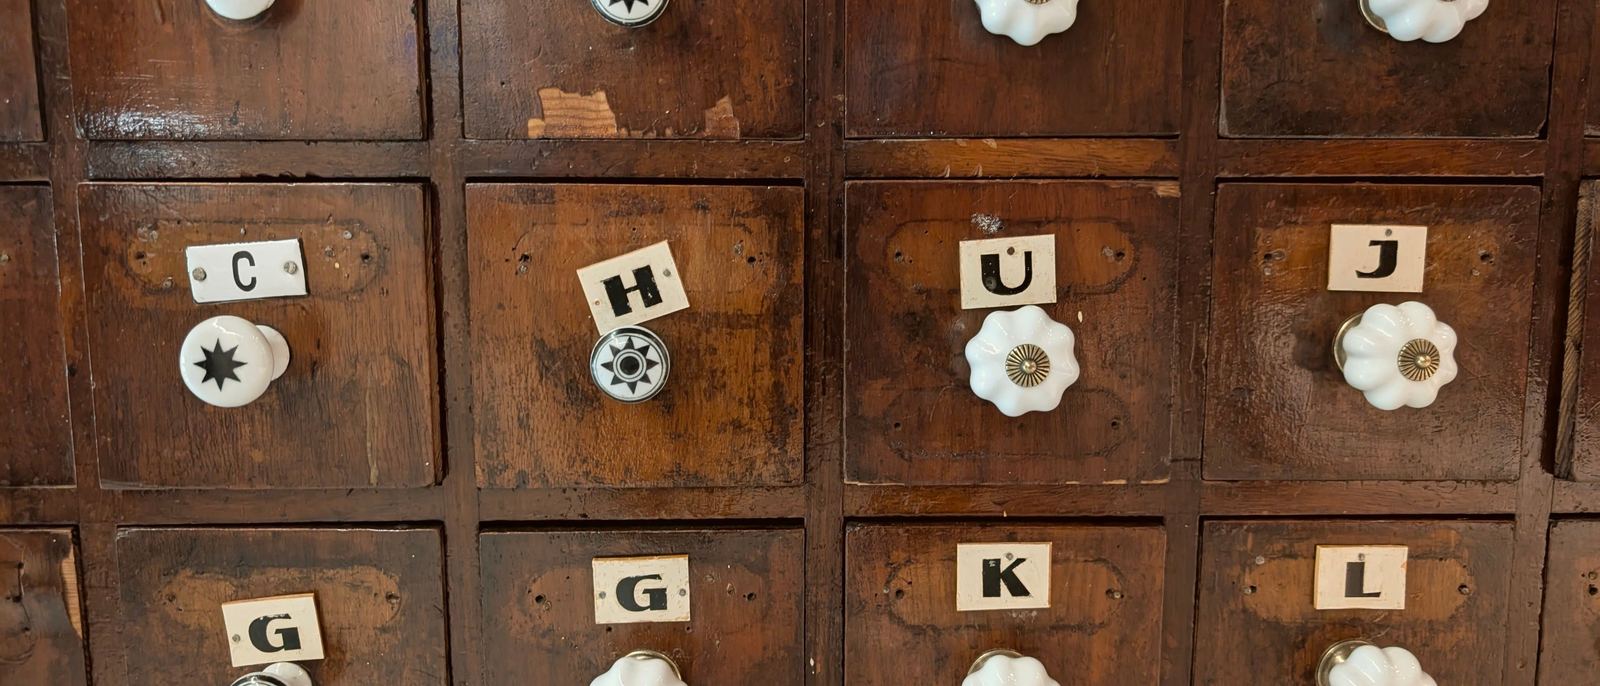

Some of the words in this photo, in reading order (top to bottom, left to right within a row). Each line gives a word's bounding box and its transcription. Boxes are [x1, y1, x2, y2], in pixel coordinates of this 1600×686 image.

[231, 250, 257, 292] C
[980, 250, 1033, 296] U
[1355, 239, 1399, 279] J
[603, 264, 663, 318] H
[616, 573, 668, 612] G
[981, 557, 1031, 598] K
[1344, 561, 1382, 598] L
[248, 613, 302, 653] G
